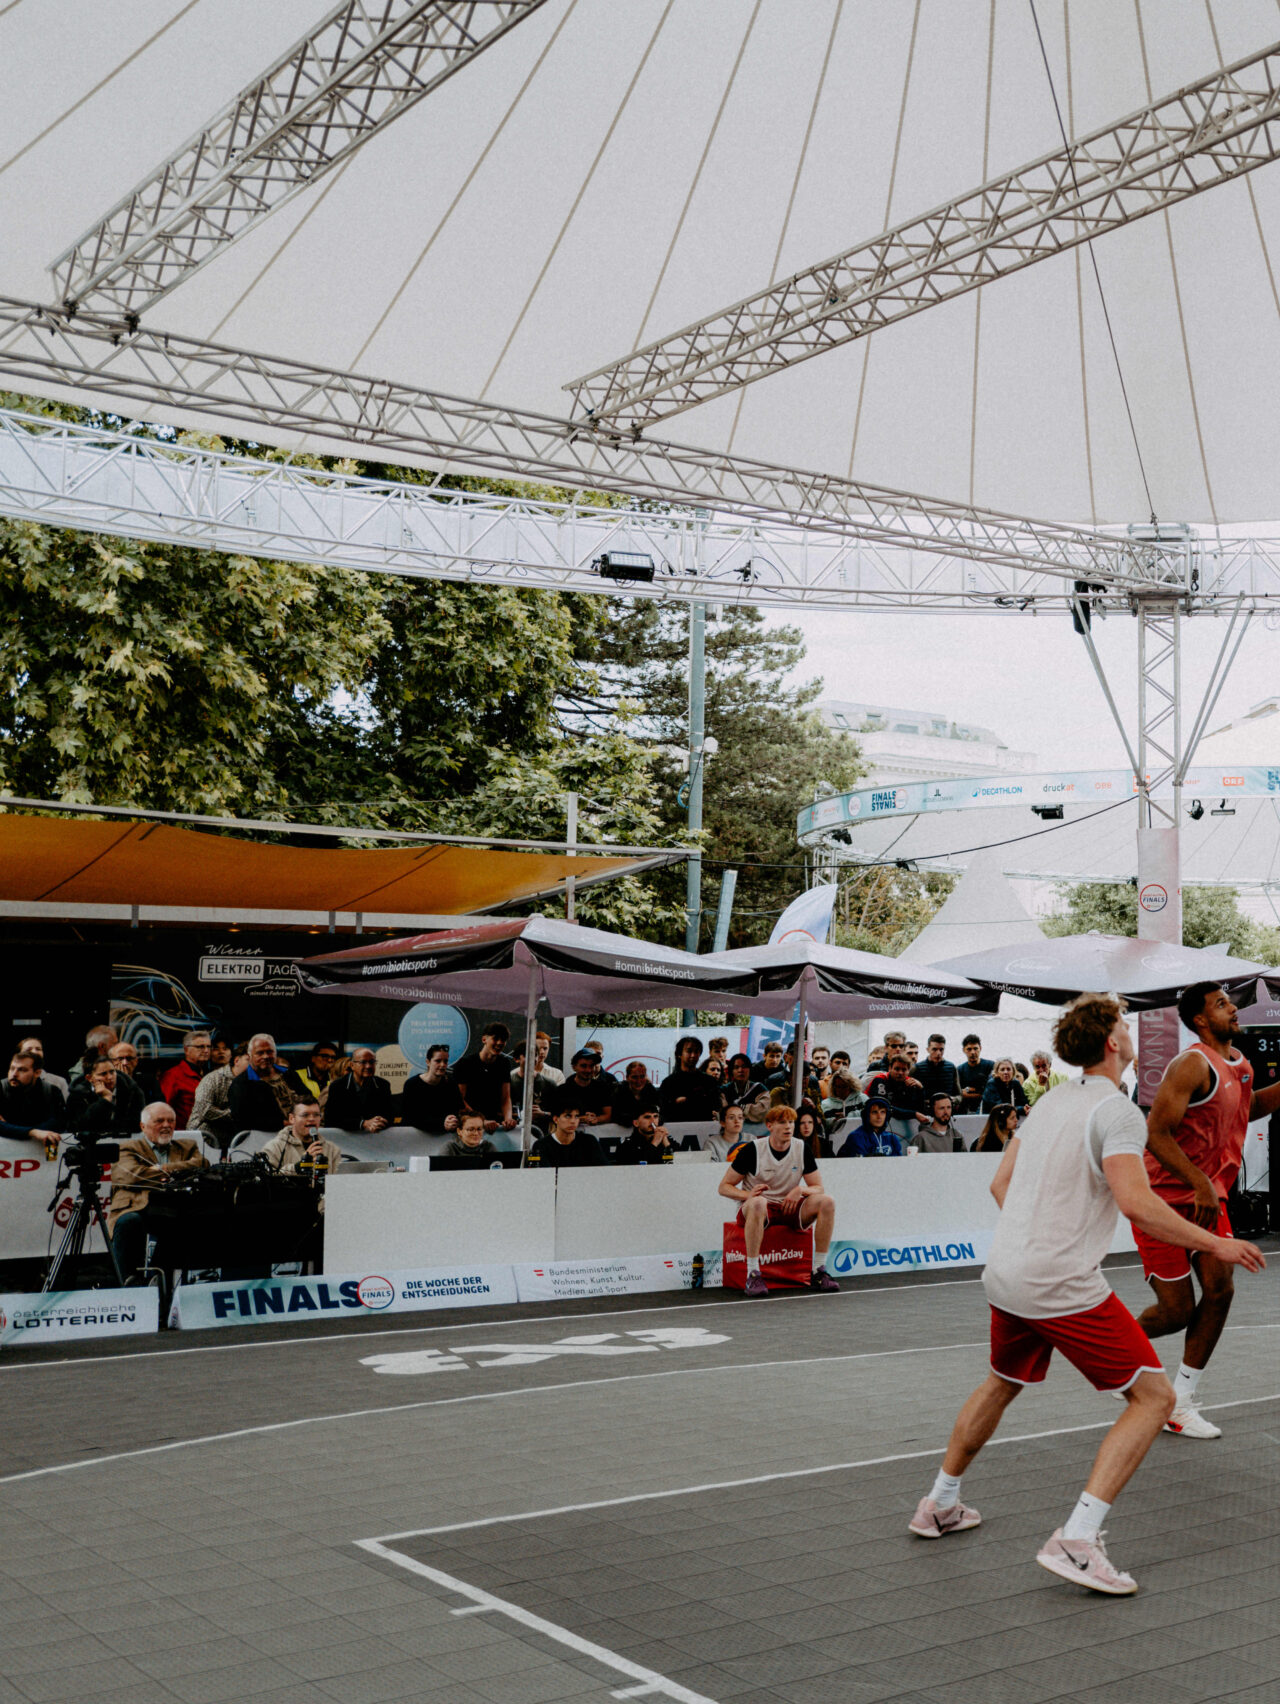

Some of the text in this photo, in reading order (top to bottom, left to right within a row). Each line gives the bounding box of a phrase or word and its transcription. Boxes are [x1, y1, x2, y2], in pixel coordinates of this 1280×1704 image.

[871, 790, 896, 803] FINALS
[981, 786, 1023, 796] DECATHLON
[205, 944, 263, 955] Wiener
[207, 963, 261, 975] ELEKTRO
[362, 957, 438, 976] #omnibioticsports
[615, 960, 695, 980] #omnibioticsports
[883, 980, 947, 998] #omnibioticsports
[759, 1248, 803, 1266] win2day
[862, 1242, 975, 1267] DECATHLON
[549, 1264, 627, 1276] Bundesministerium
[406, 1275, 482, 1290] DIE WOCHE DER
[552, 1278, 588, 1287] Wohnen,
[590, 1276, 614, 1285] Kunst,
[362, 1290, 391, 1298] FINALS
[402, 1285, 490, 1299] ENTSCHEIDUNGEN
[554, 1284, 628, 1297] Medien und Sport
[212, 1281, 365, 1319] FINALS
[13, 1305, 136, 1318] österreichische
[13, 1313, 136, 1329] LOTTERIEN
